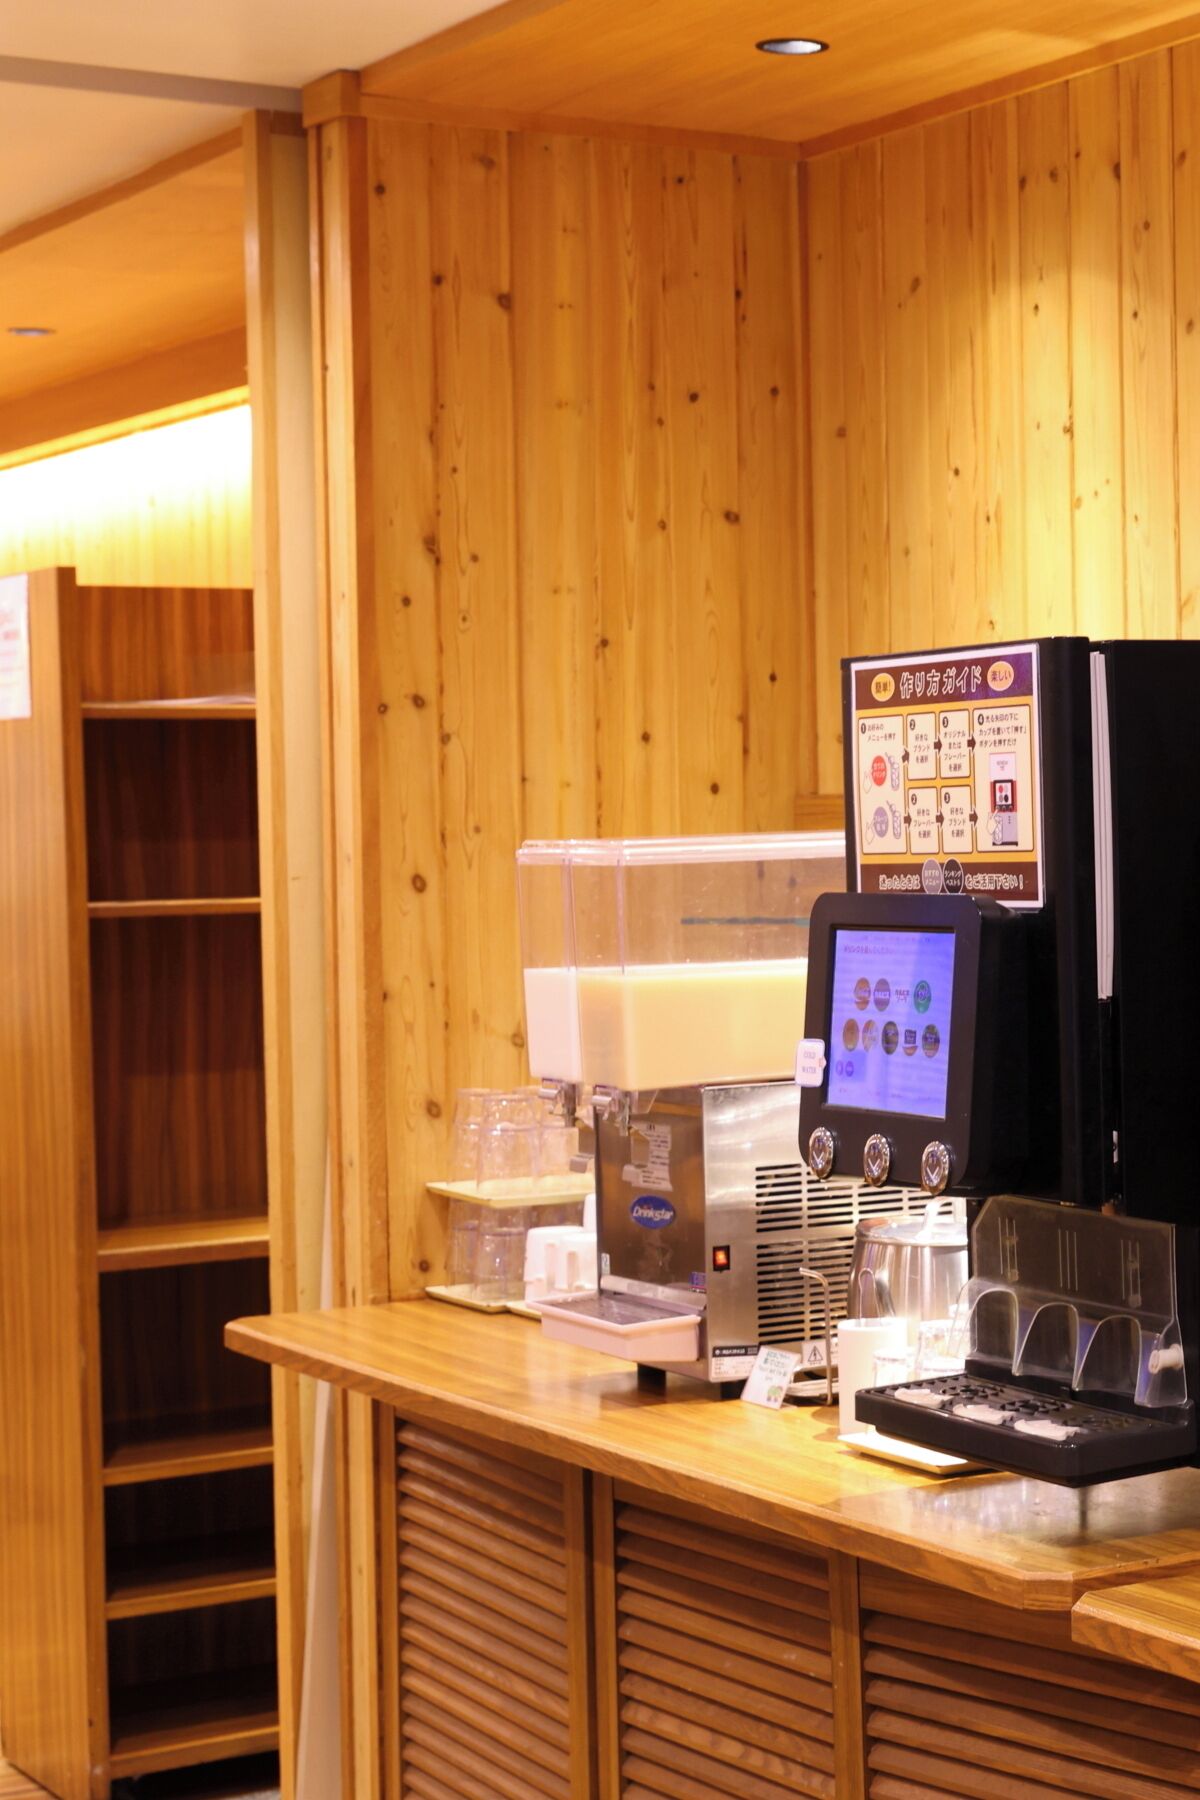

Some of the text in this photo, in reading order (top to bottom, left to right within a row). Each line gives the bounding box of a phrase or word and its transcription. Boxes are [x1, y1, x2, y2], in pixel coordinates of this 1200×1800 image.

[900, 665, 982, 699] 作り方ガイド
